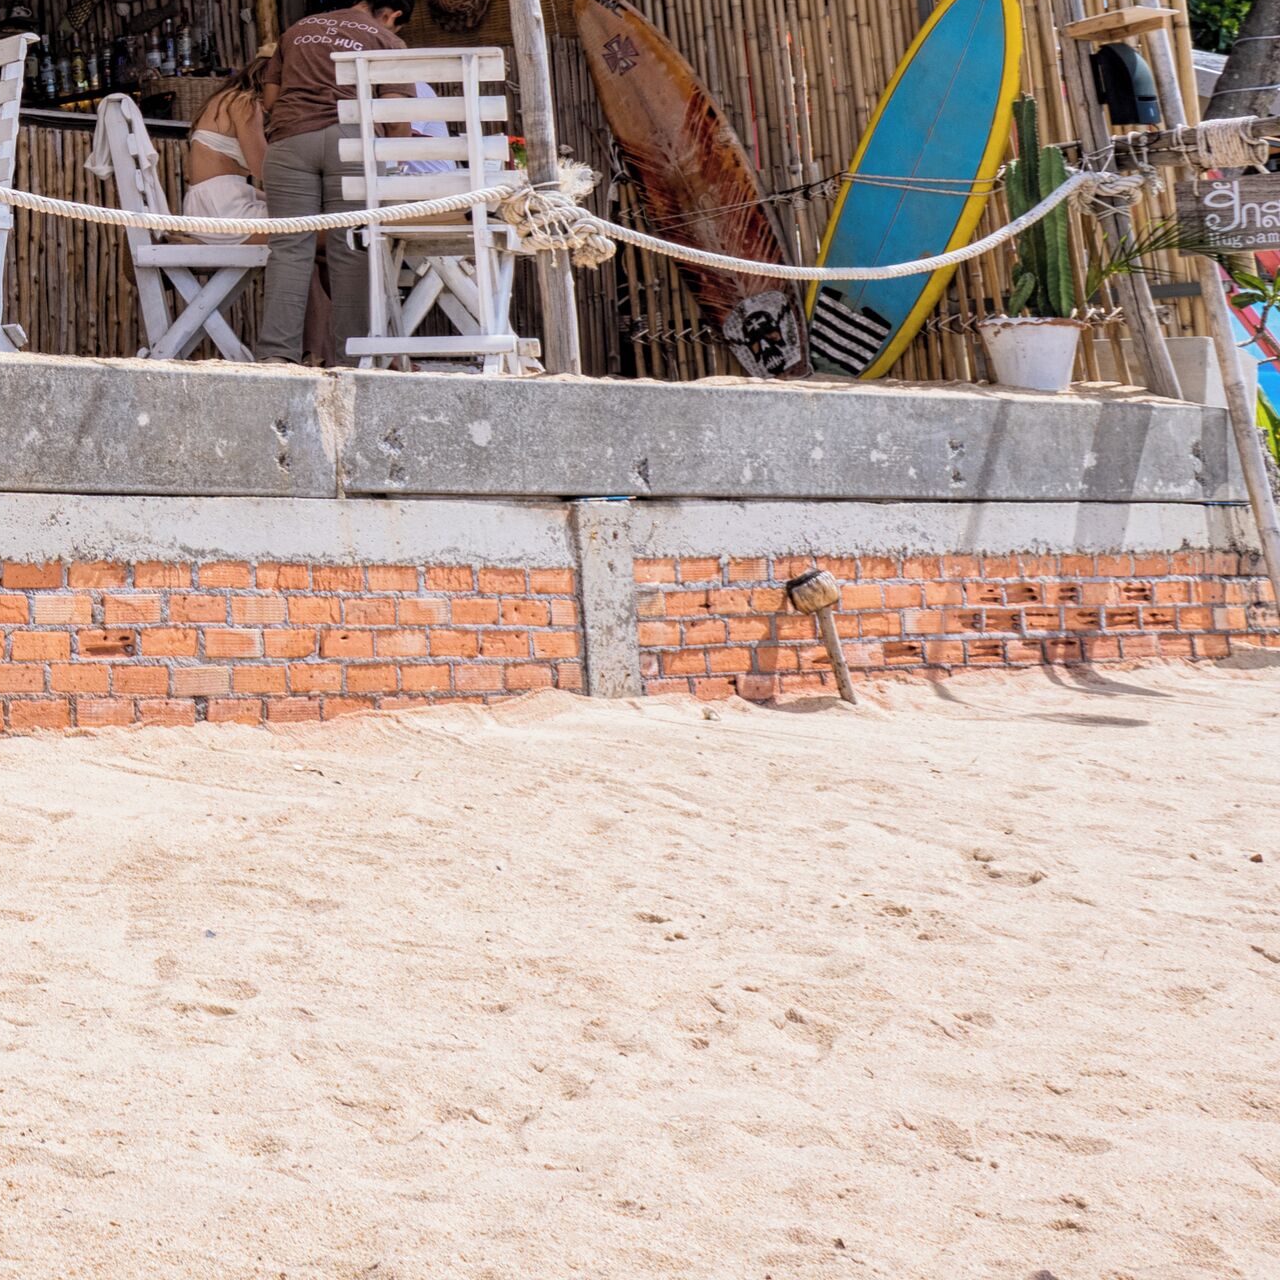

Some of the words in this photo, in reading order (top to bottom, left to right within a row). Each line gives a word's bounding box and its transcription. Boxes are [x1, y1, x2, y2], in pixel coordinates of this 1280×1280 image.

[298, 17, 337, 26] GOOD
[339, 20, 378, 34] FOOD
[326, 27, 338, 35] IS
[294, 35, 332, 45] GOOD
[334, 38, 364, 51] HUG
